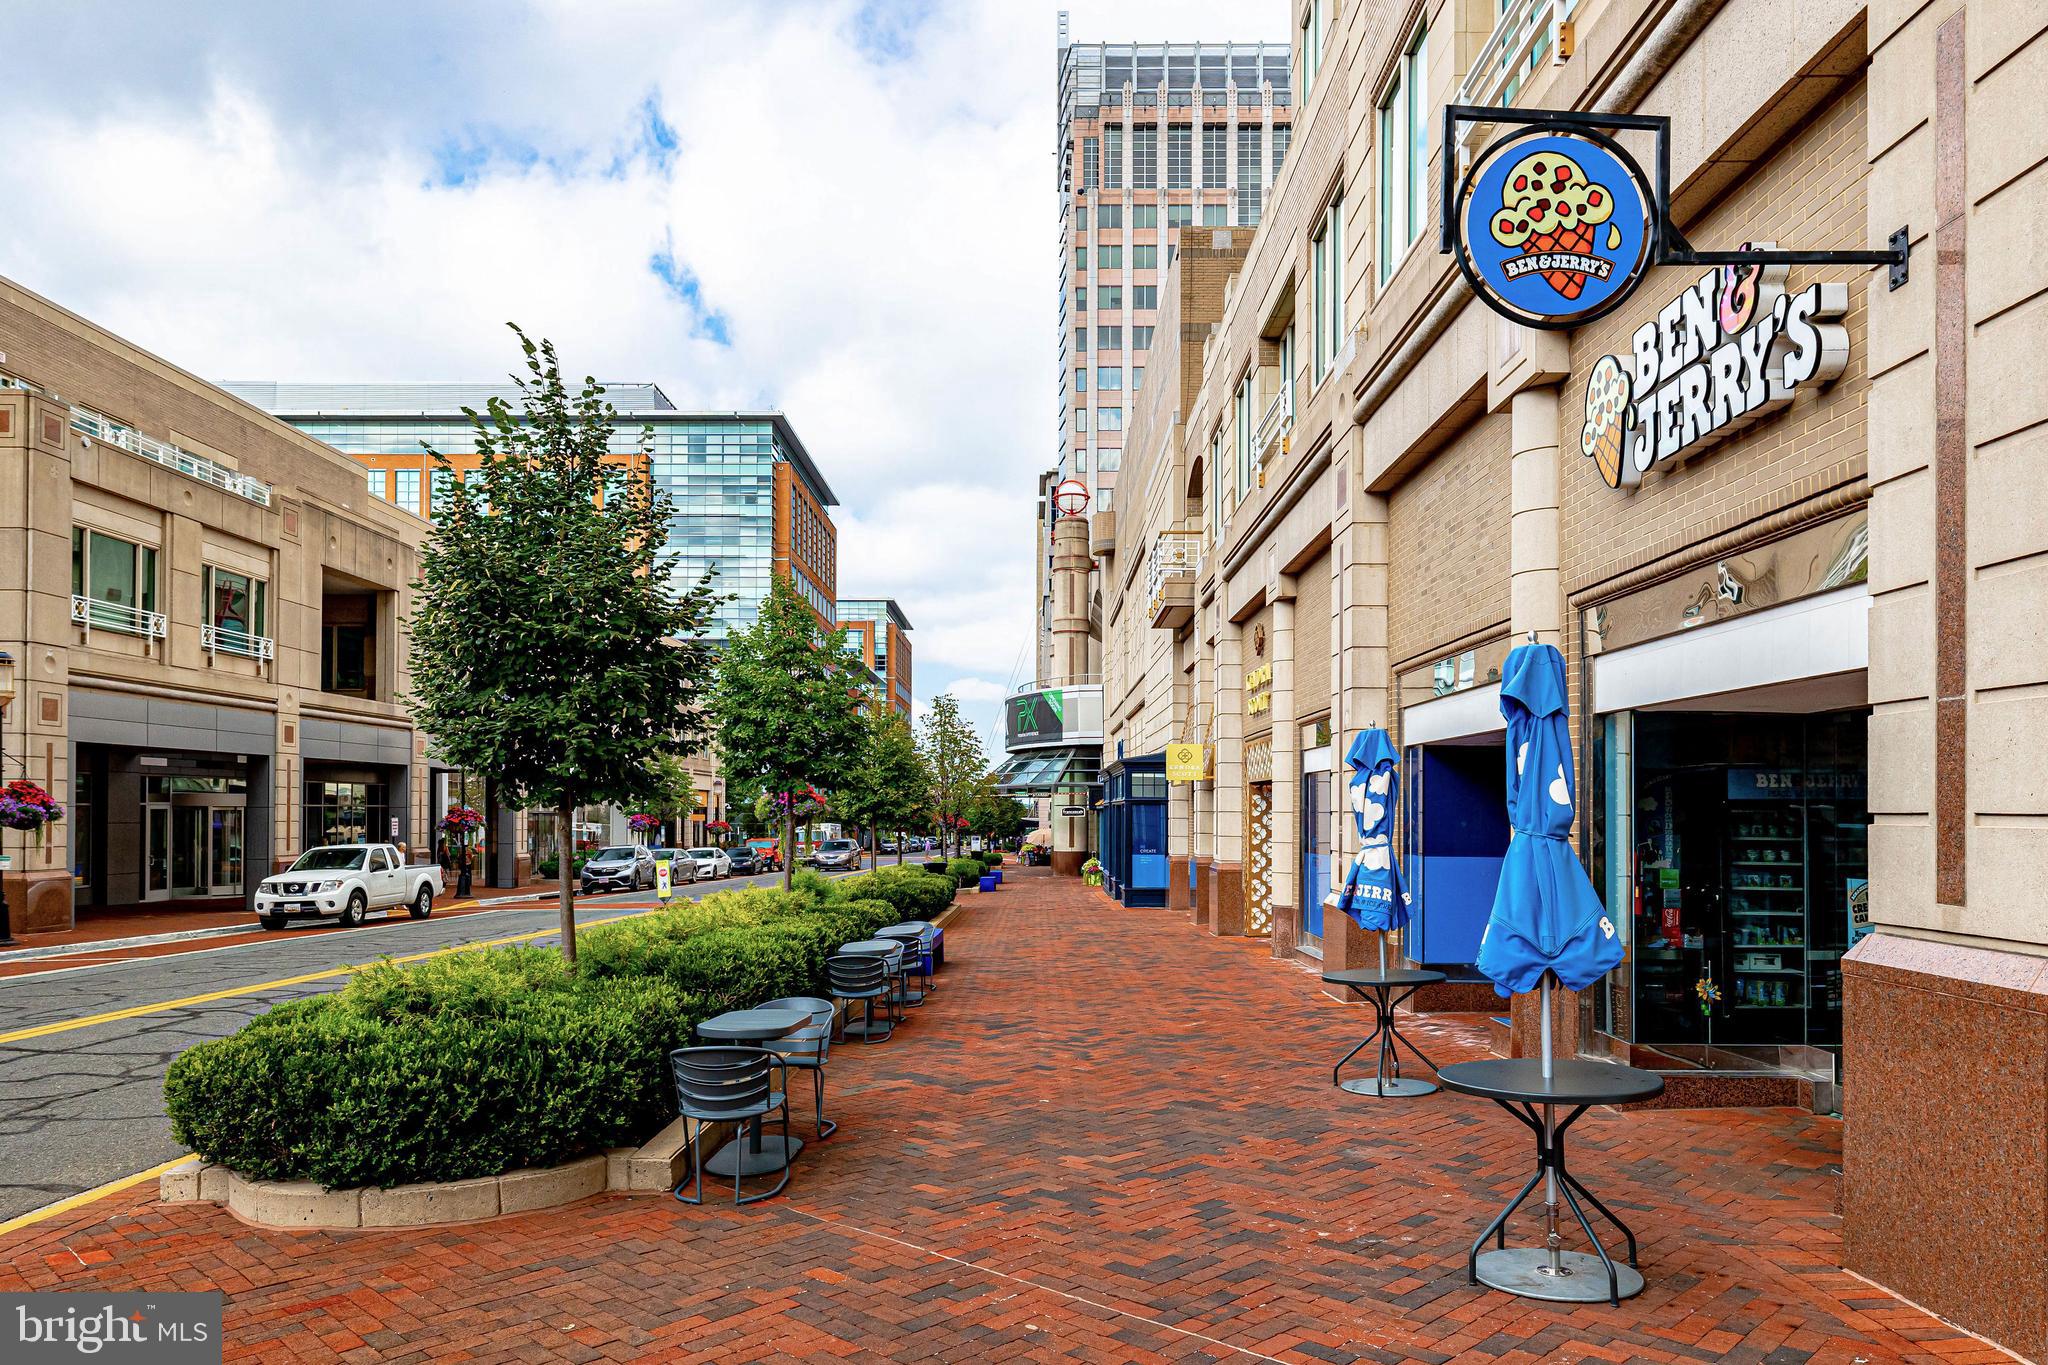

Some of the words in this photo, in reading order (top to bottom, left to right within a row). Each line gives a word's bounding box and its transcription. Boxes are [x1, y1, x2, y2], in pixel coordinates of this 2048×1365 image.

[1632, 268, 1721, 400] BEN
[1633, 283, 1821, 472] JERRY'S
[1755, 773, 1793, 788] BEN
